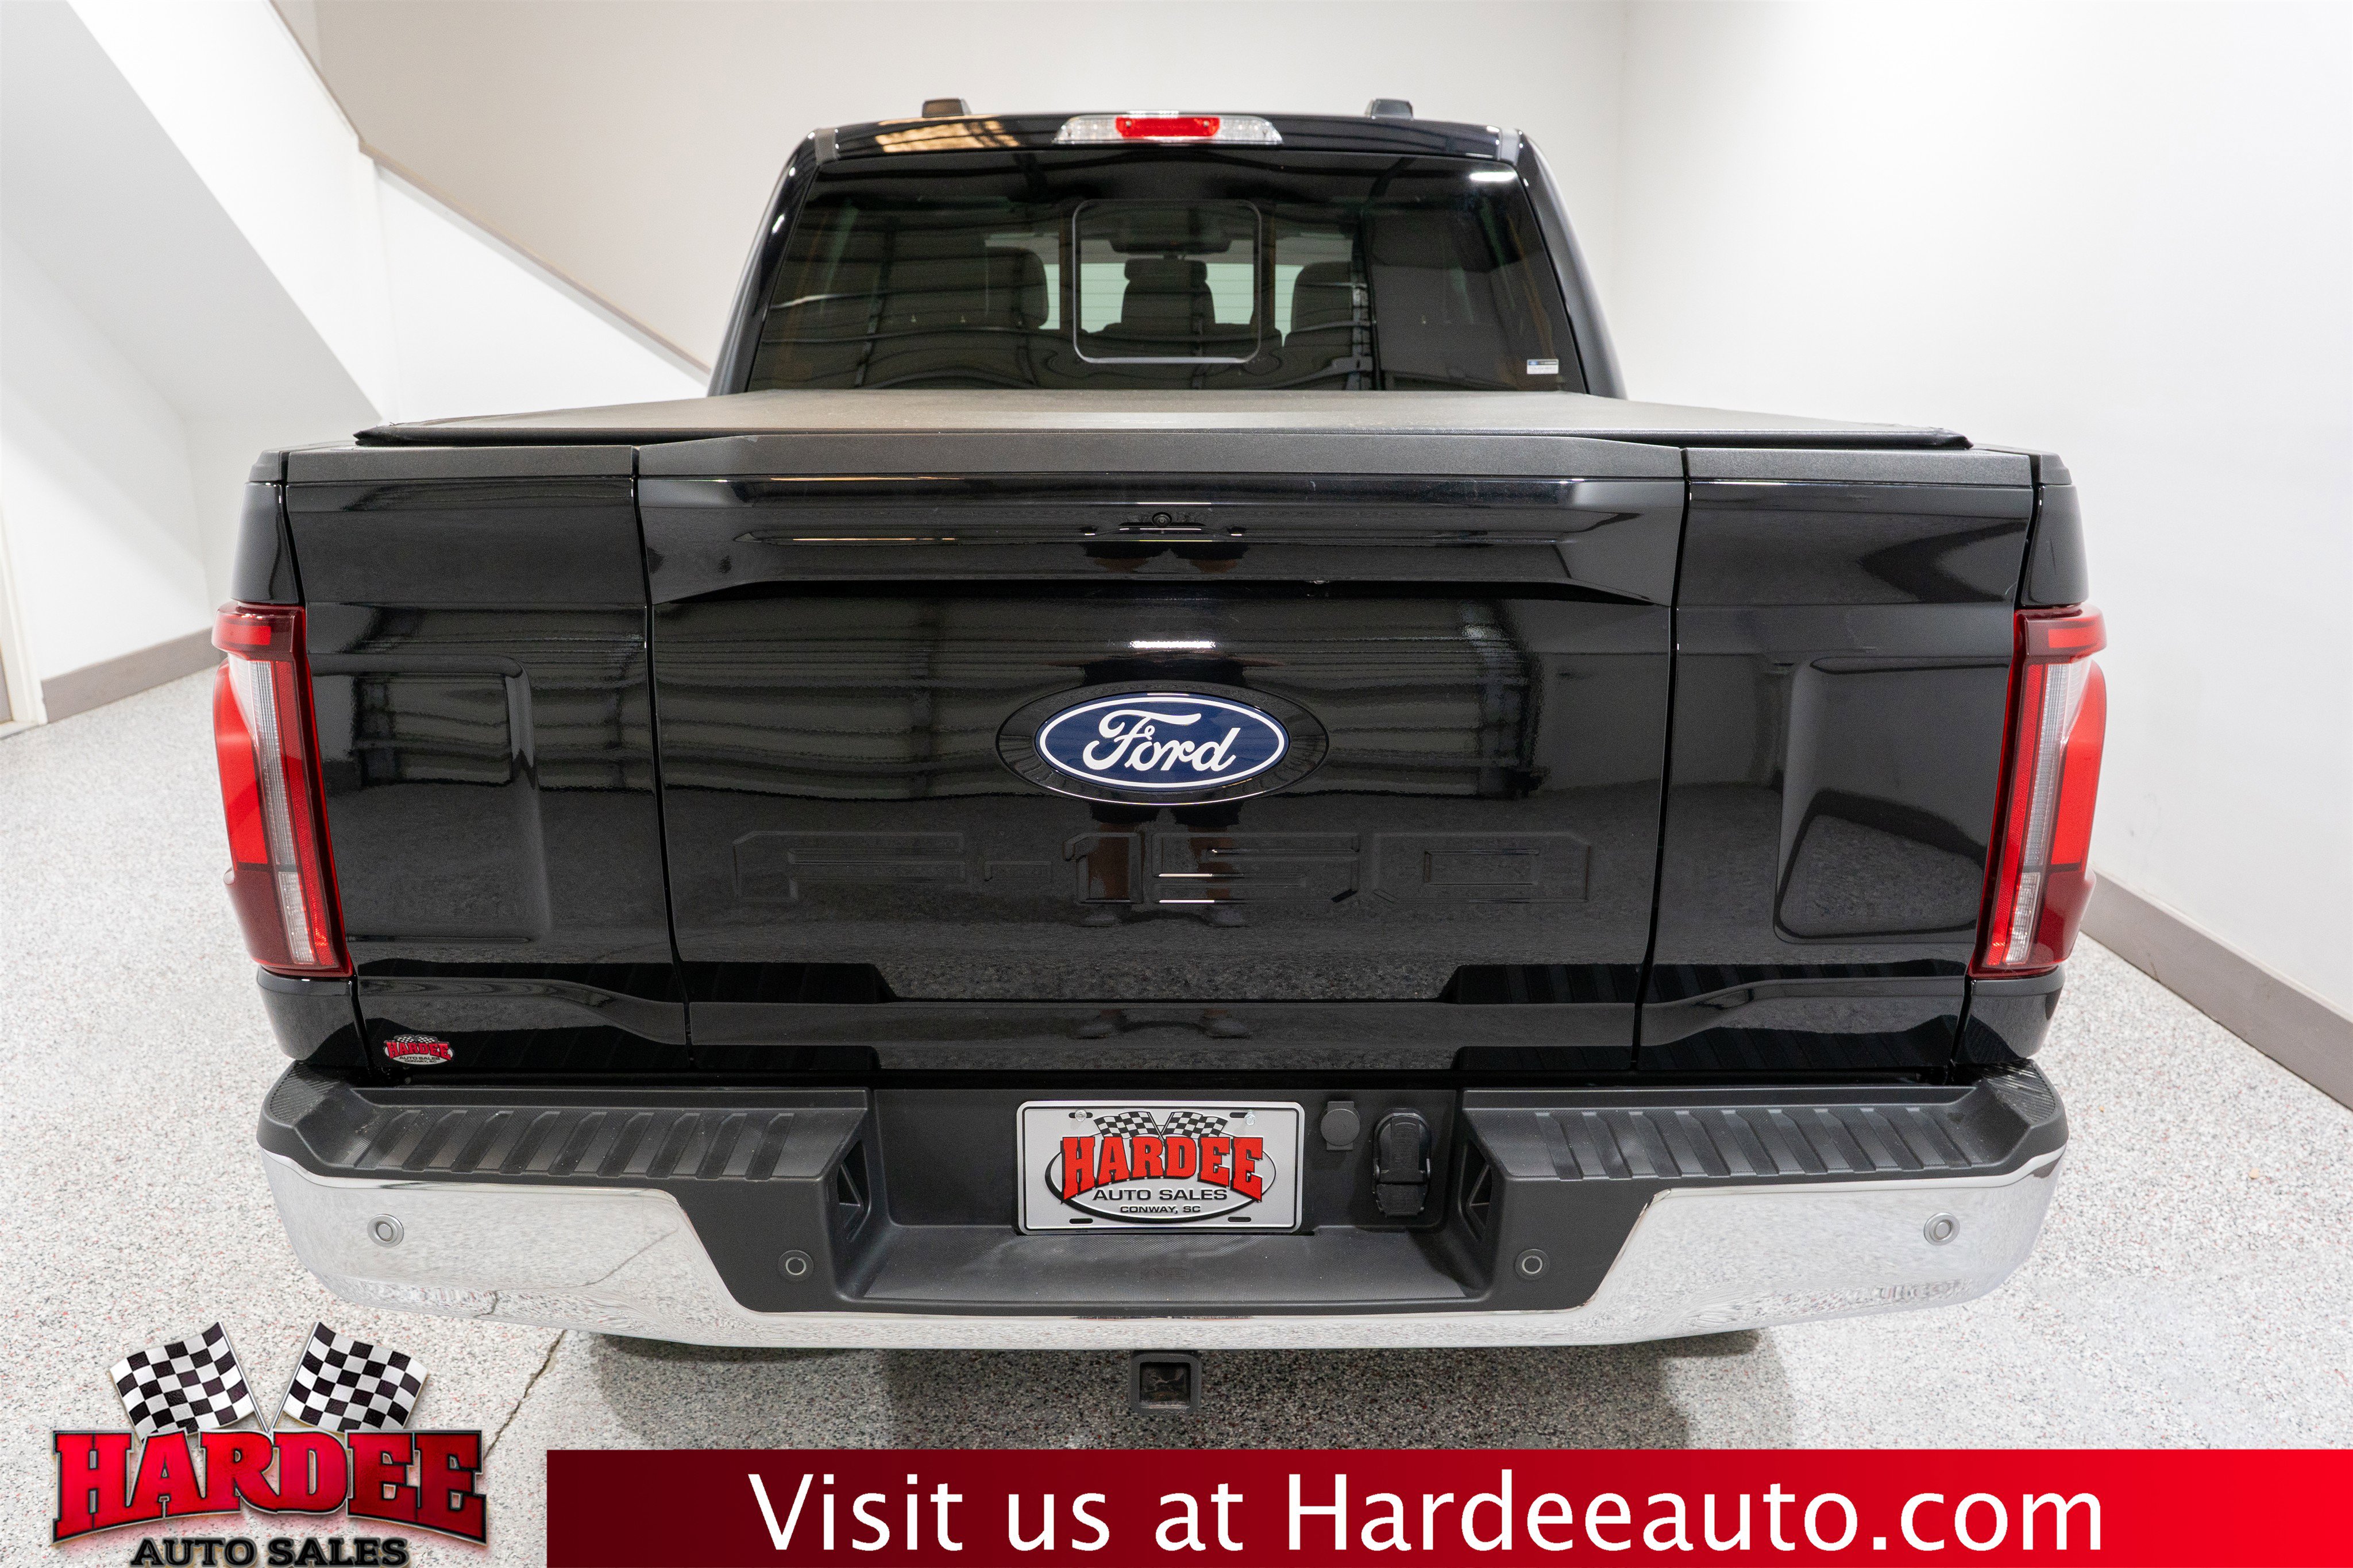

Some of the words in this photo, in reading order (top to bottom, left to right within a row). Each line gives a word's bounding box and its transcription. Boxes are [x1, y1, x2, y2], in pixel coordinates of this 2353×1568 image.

[1083, 709, 1241, 771] Ford
[733, 830, 1592, 903] F-150
[386, 1041, 451, 1060] HARDEE
[1060, 1136, 1264, 1204] HARDEE
[1093, 1189, 1152, 1201] AUTO
[1159, 1189, 1228, 1201] SALES
[1120, 1205, 1178, 1214] CONWAY,
[1183, 1205, 1201, 1213] SC
